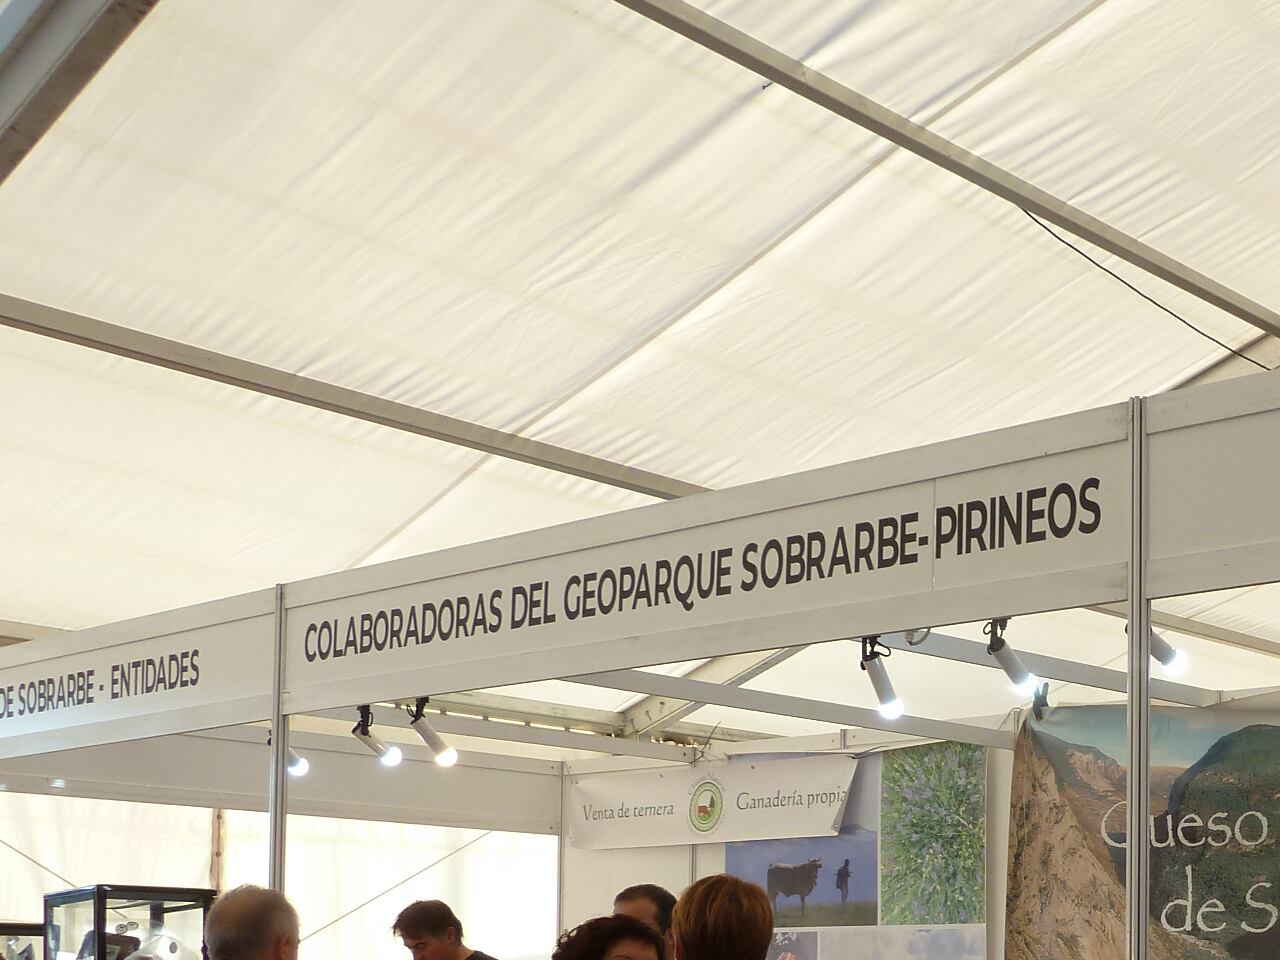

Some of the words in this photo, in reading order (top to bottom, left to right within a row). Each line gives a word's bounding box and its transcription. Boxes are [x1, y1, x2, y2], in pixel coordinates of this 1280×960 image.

[305, 589, 503, 662] COLABORADORAS
[510, 581, 556, 630] DEL
[563, 548, 733, 620] GEOPARQUE
[741, 477, 1101, 592] SOBRARBE-PIRINEOS
[18, 670, 95, 715] SOBRARBE
[111, 649, 200, 700] ENTIDADES
[583, 804, 615, 821] Venta
[617, 803, 630, 818] de
[633, 803, 674, 818] ternera
[736, 789, 803, 810] Ganadería
[807, 785, 848, 806] propia
[1161, 865, 1226, 933] de
